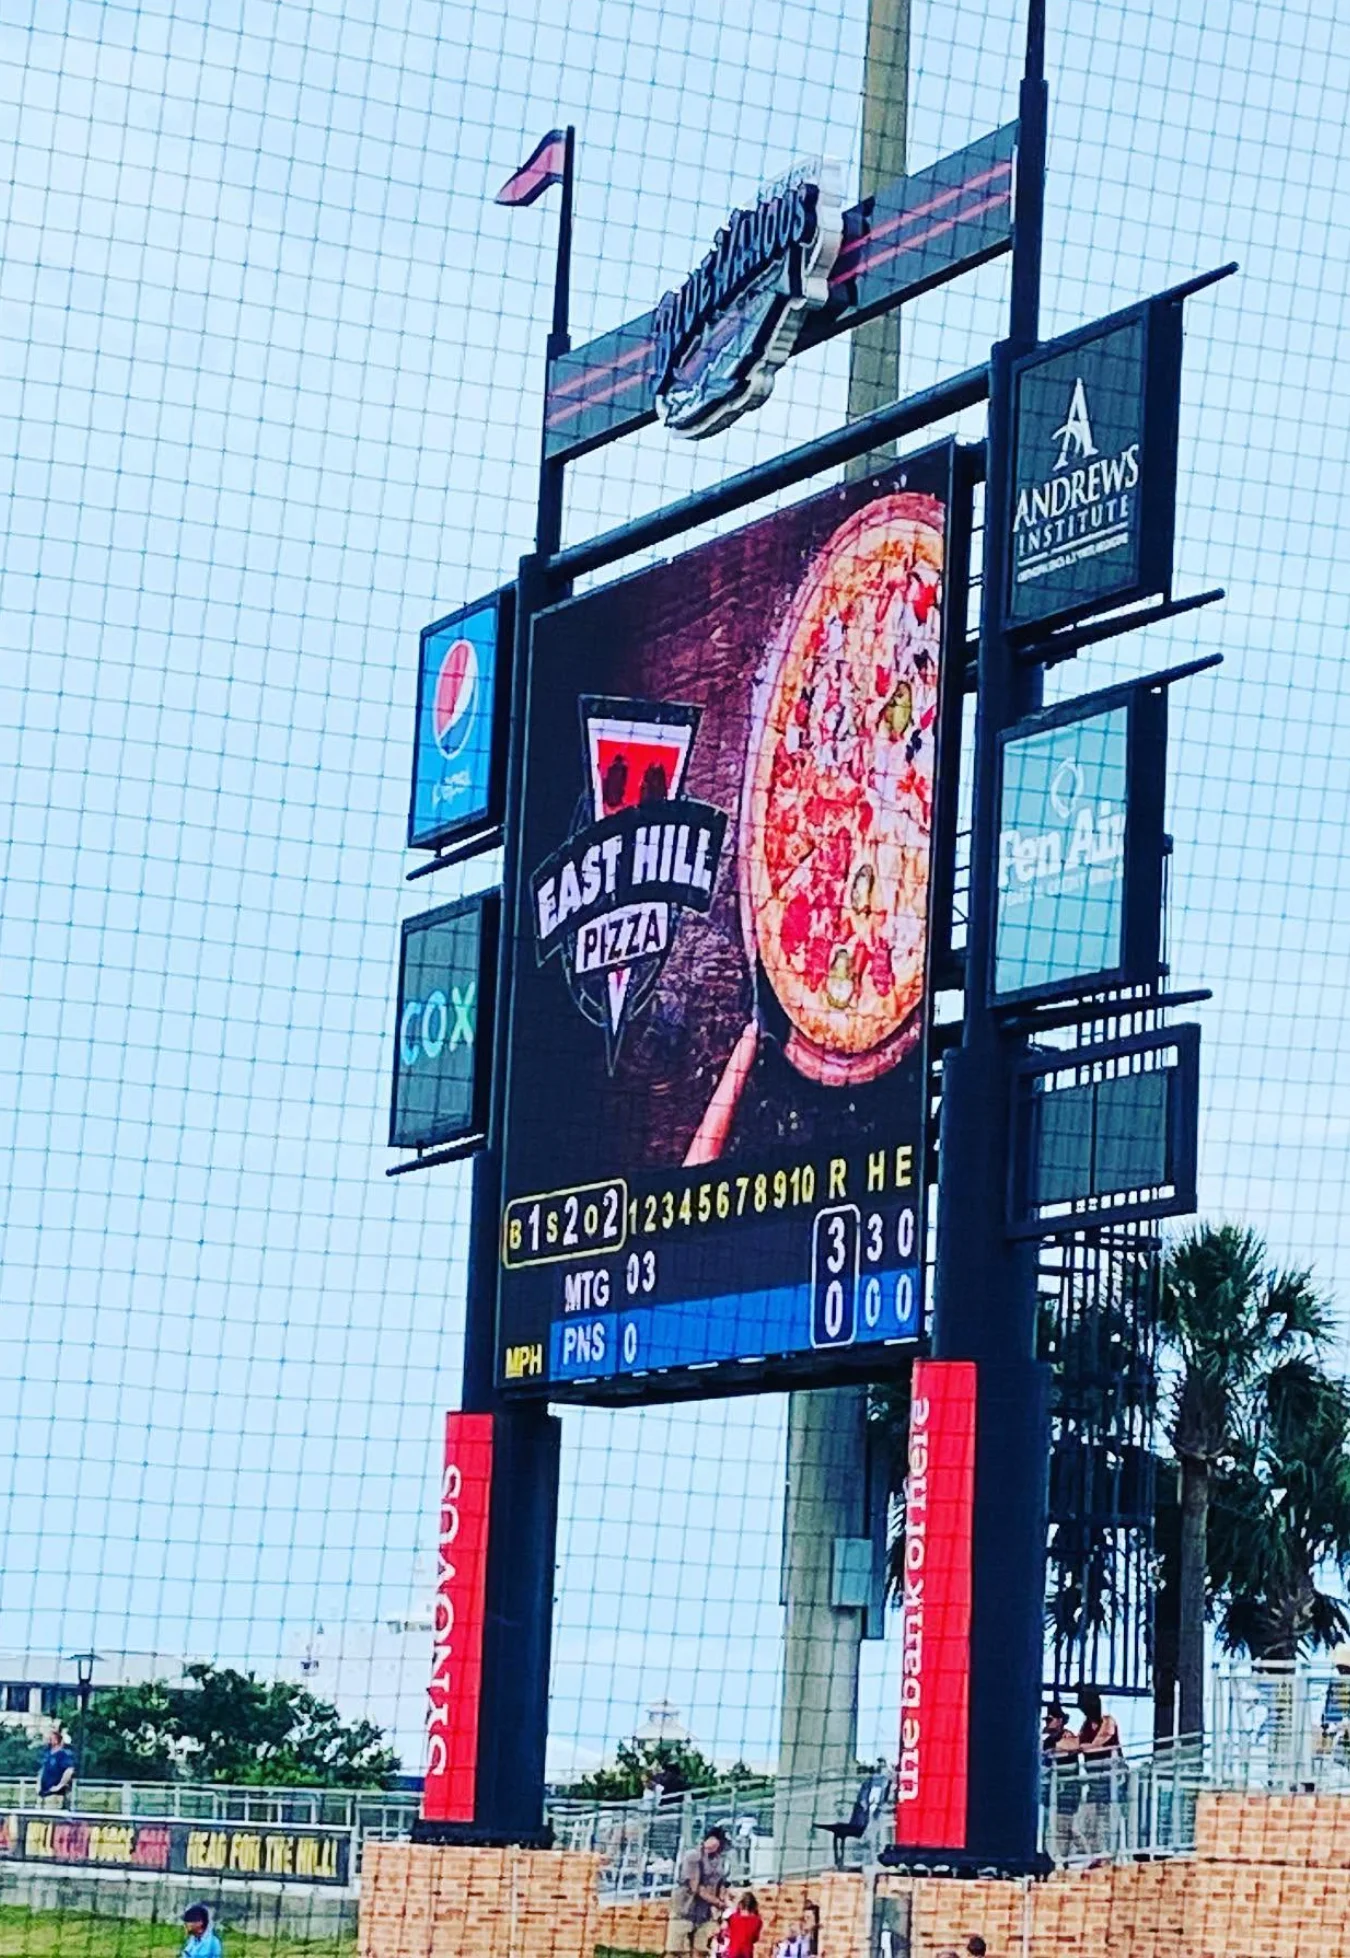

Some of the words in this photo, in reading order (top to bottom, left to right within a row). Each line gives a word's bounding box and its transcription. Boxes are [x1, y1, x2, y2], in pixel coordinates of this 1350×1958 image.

[1012, 444, 1139, 532] ANDREWS
[1018, 494, 1129, 556] INSTITUTE
[537, 834, 622, 939] EAST
[632, 823, 712, 890] HILL
[583, 908, 661, 969] PIZZA
[400, 981, 476, 1065] COX
[829, 1158, 846, 1199] R
[868, 1150, 885, 1191] H
[896, 1145, 912, 1187] E
[509, 1219, 521, 1249] B
[528, 1204, 540, 1250] 1
[563, 1196, 578, 1246] 2
[603, 1188, 618, 1238] 2
[565, 1270, 609, 1312] MTG
[827, 1217, 845, 1273] 3
[867, 1214, 883, 1261] 3
[898, 1208, 914, 1257] 0
[505, 1344, 542, 1378] MPH
[563, 1322, 604, 1365] PNS
[624, 1322, 637, 1364] 0
[825, 1280, 843, 1337] 0
[865, 1278, 881, 1327] 0
[896, 1274, 912, 1322] 0
[424, 1464, 462, 1776] SYNOVUS
